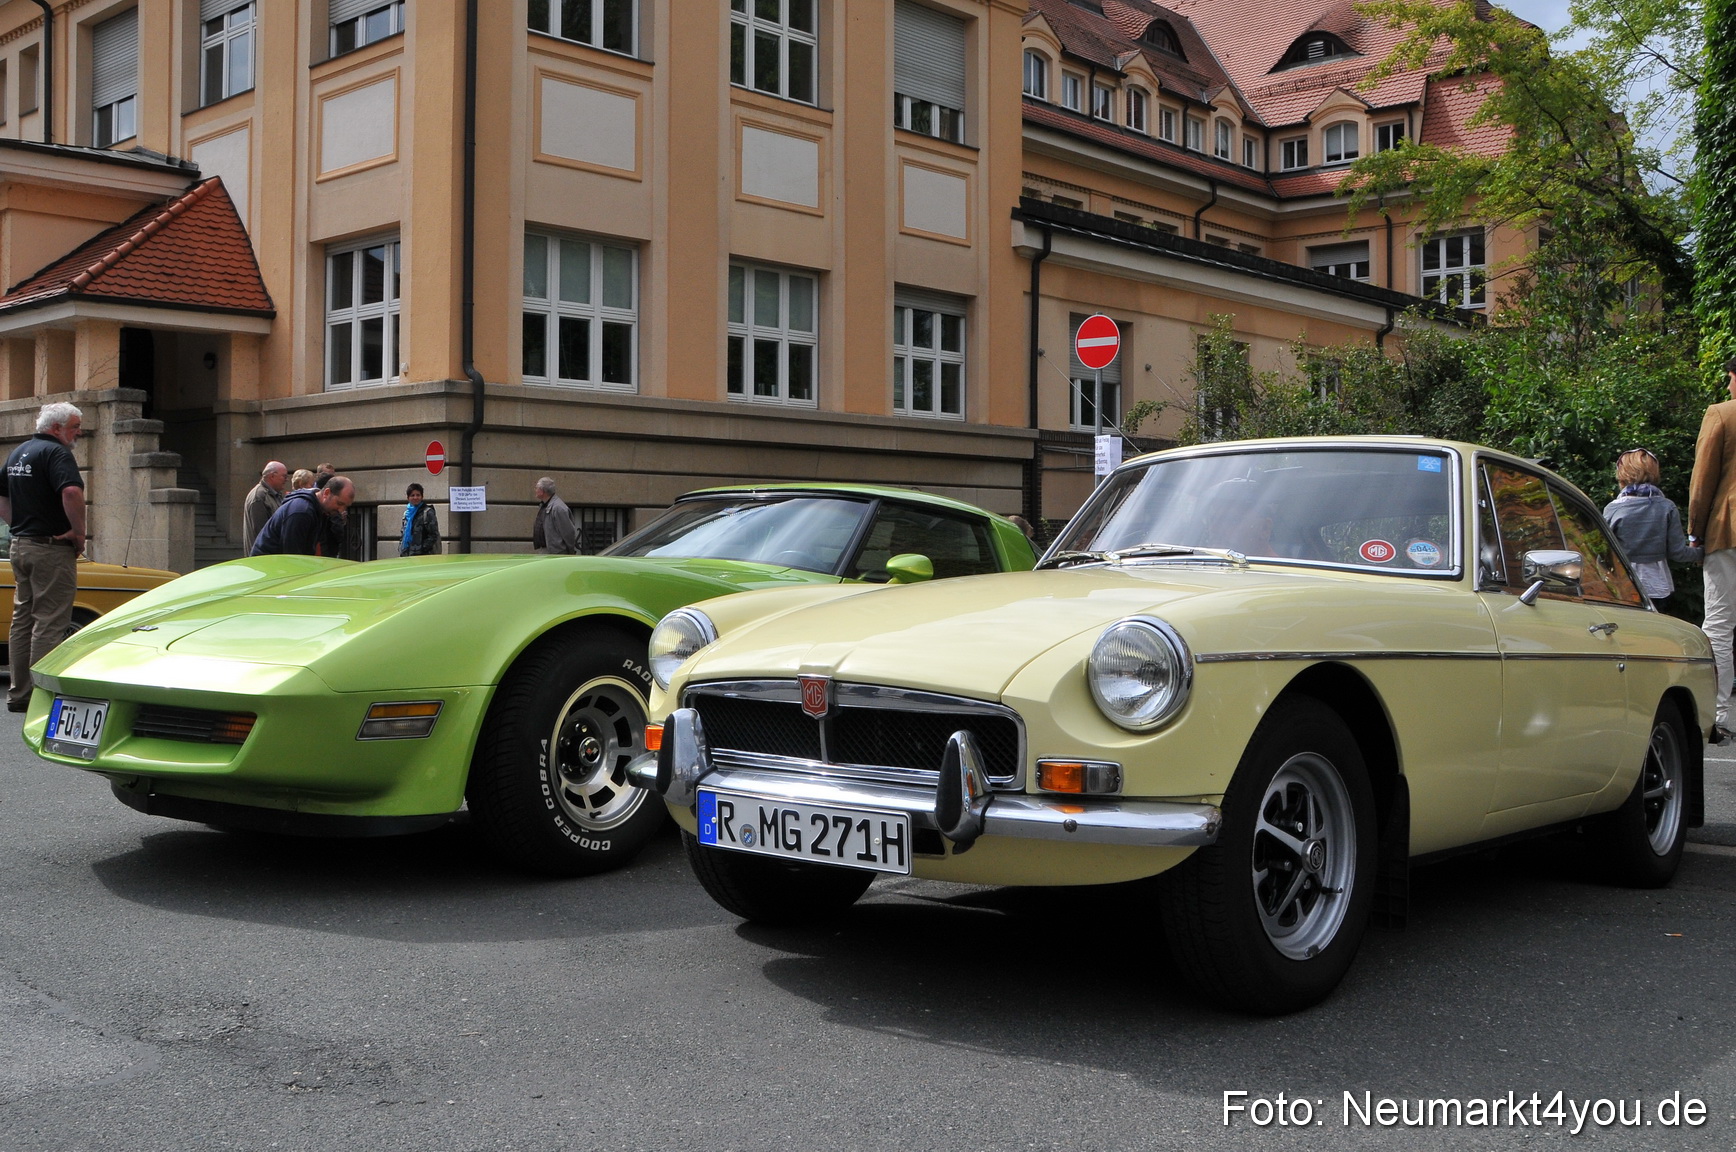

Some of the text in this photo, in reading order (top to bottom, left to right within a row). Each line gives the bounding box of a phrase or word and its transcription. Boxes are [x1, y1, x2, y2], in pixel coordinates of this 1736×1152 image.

[1370, 545, 1386, 557] MG
[622, 659, 653, 687] RAD
[806, 685, 822, 705] MG
[539, 739, 611, 851] COOPER COBRA
[704, 823, 711, 835] D
[717, 800, 905, 866] R MG 271H
